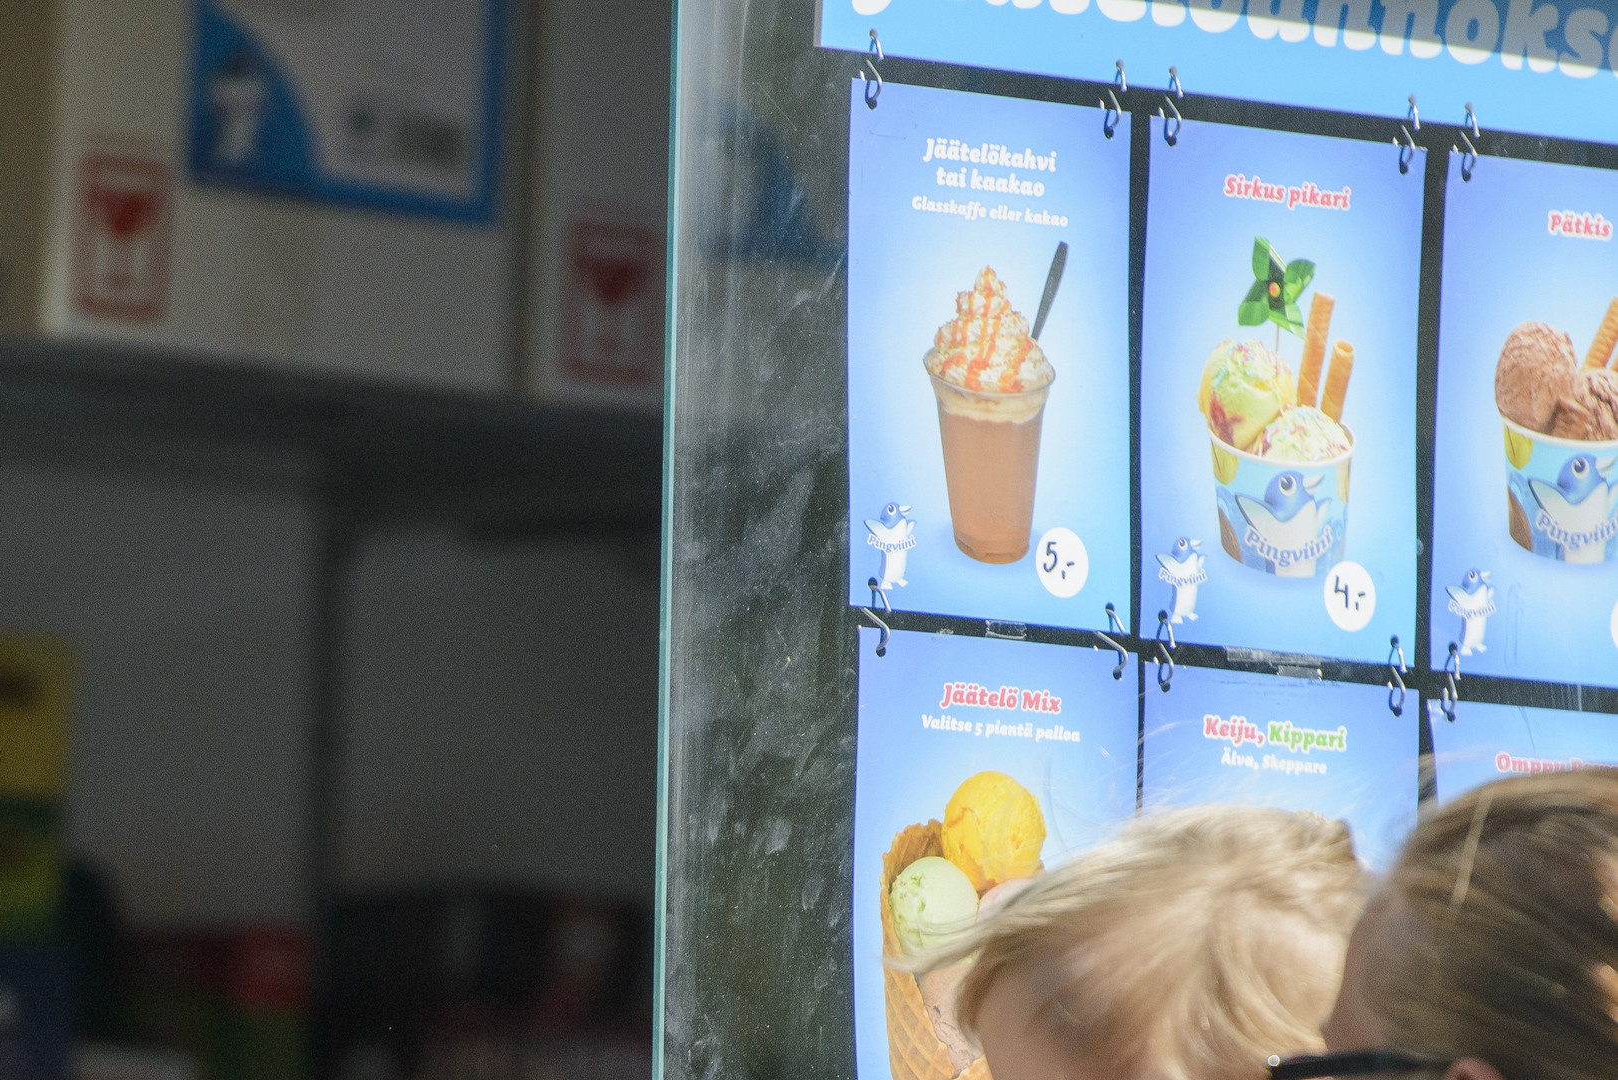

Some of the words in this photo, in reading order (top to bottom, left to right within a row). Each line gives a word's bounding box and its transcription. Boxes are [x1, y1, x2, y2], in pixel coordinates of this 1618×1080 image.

[923, 137, 1057, 172] Jäätelökahvi
[936, 166, 967, 188] tai
[970, 168, 1045, 197] kaakao
[1223, 173, 1285, 203] Sirkus
[1287, 181, 1351, 210] pikari
[911, 195, 987, 221] Glasskaffe
[990, 204, 1023, 222] eller
[1024, 207, 1069, 227] kakao
[1548, 210, 1614, 241] Pätkis
[867, 533, 916, 553] Pingviini
[1536, 511, 1618, 550] Pingviin
[1244, 526, 1333, 568] Pingviini
[1159, 568, 1208, 588] Pingviini
[940, 682, 1019, 709] Jäätelö
[1020, 689, 1062, 714] Mix
[921, 714, 973, 732] Valitse
[974, 722, 983, 736] 5
[985, 719, 1033, 738] pientä
[1035, 725, 1081, 743] palloa
[1203, 714, 1266, 748] Keiju,
[1268, 720, 1347, 754] Kippari
[1221, 746, 1259, 770] Älva,
[1262, 754, 1327, 776] Skeppare
